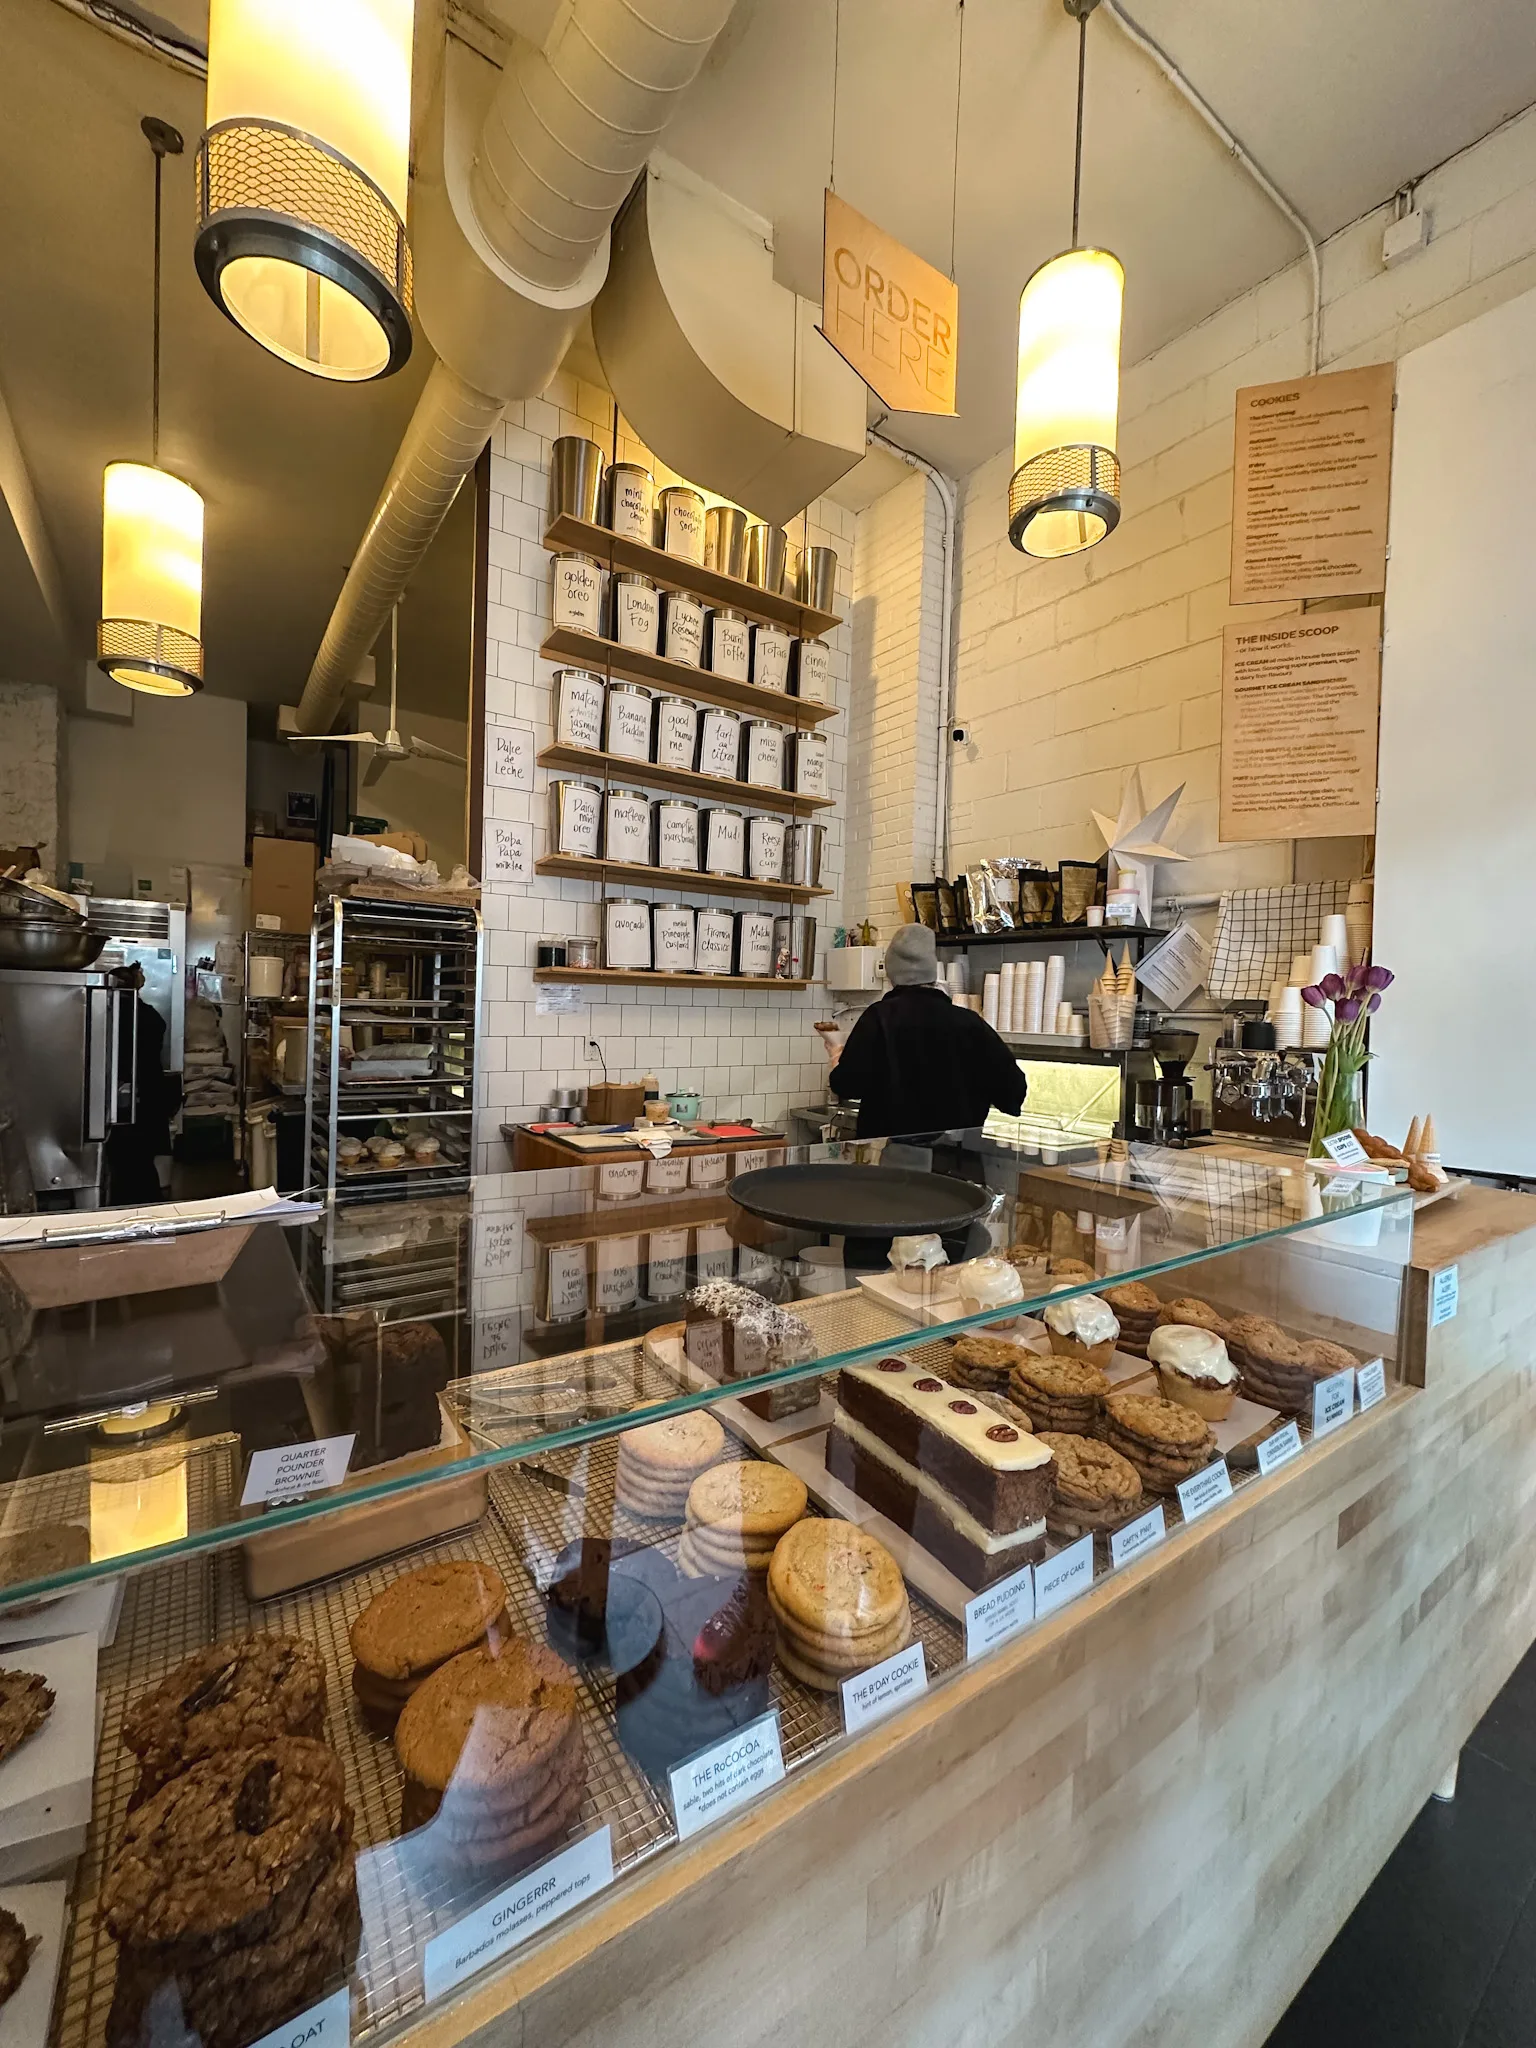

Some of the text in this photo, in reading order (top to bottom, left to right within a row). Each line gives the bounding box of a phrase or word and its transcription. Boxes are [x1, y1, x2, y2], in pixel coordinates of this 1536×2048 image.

[833, 247, 950, 355] ORDER
[836, 283, 947, 402] HERE
[1250, 392, 1300, 407] COOKIES
[626, 488, 643, 500] mint
[630, 512, 644, 524] chip
[562, 569, 595, 590] golden
[568, 589, 589, 601] oreo
[626, 594, 655, 615] London
[630, 612, 649, 632] Fog
[675, 606, 699, 626] Lychee
[722, 629, 744, 645] Burnt
[1236, 626, 1339, 645] THE INSIDE SCOOP
[720, 644, 745, 662] Toffee
[1234, 685, 1266, 693] GOURMET
[617, 705, 647, 724] Banana
[668, 715, 689, 731] good
[715, 724, 734, 745] tart
[760, 736, 777, 747] miso
[496, 737, 522, 755] Dulce
[670, 740, 683, 752] me
[718, 741, 727, 749] au
[504, 754, 514, 764] de
[712, 747, 735, 764] citron
[758, 752, 778, 768] cherry
[495, 761, 524, 779] Leche
[574, 798, 595, 813] Dairy
[579, 813, 598, 824] mint
[573, 824, 591, 833] oreo
[624, 825, 640, 837] me
[496, 829, 522, 846] Boba
[498, 844, 522, 860] Papa
[662, 927, 690, 941] pineapple
[666, 940, 689, 950] custard
[1332, 1398, 1345, 1410] CREAM
[281, 1447, 326, 1463] QUARTER
[276, 1459, 324, 1474] POUNDER
[274, 1470, 321, 1486] BROWNIE
[1182, 1490, 1190, 1499] THE
[1190, 1476, 1212, 1495] EVERYTHING
[1212, 1468, 1226, 1481] COOKIE
[1044, 1561, 1085, 1595] PIECE OF CAKE
[974, 1580, 1025, 1620] BREAD PUDDING
[852, 1659, 919, 1704] THE B'DAY COOKIE
[862, 1701, 871, 1710] hint
[872, 1698, 877, 1706] of
[894, 1678, 913, 1695] sprinkles
[693, 1739, 760, 1788] THE RoCOCOA
[683, 1748, 773, 1810] sable, two hits of dark chocolate
[717, 1791, 727, 1801] not
[728, 1776, 750, 1794] contain
[750, 1768, 764, 1781] eggs
[492, 1876, 556, 1927] GINGERRR
[454, 1872, 591, 1969] Barbados molasses, peppered tops
